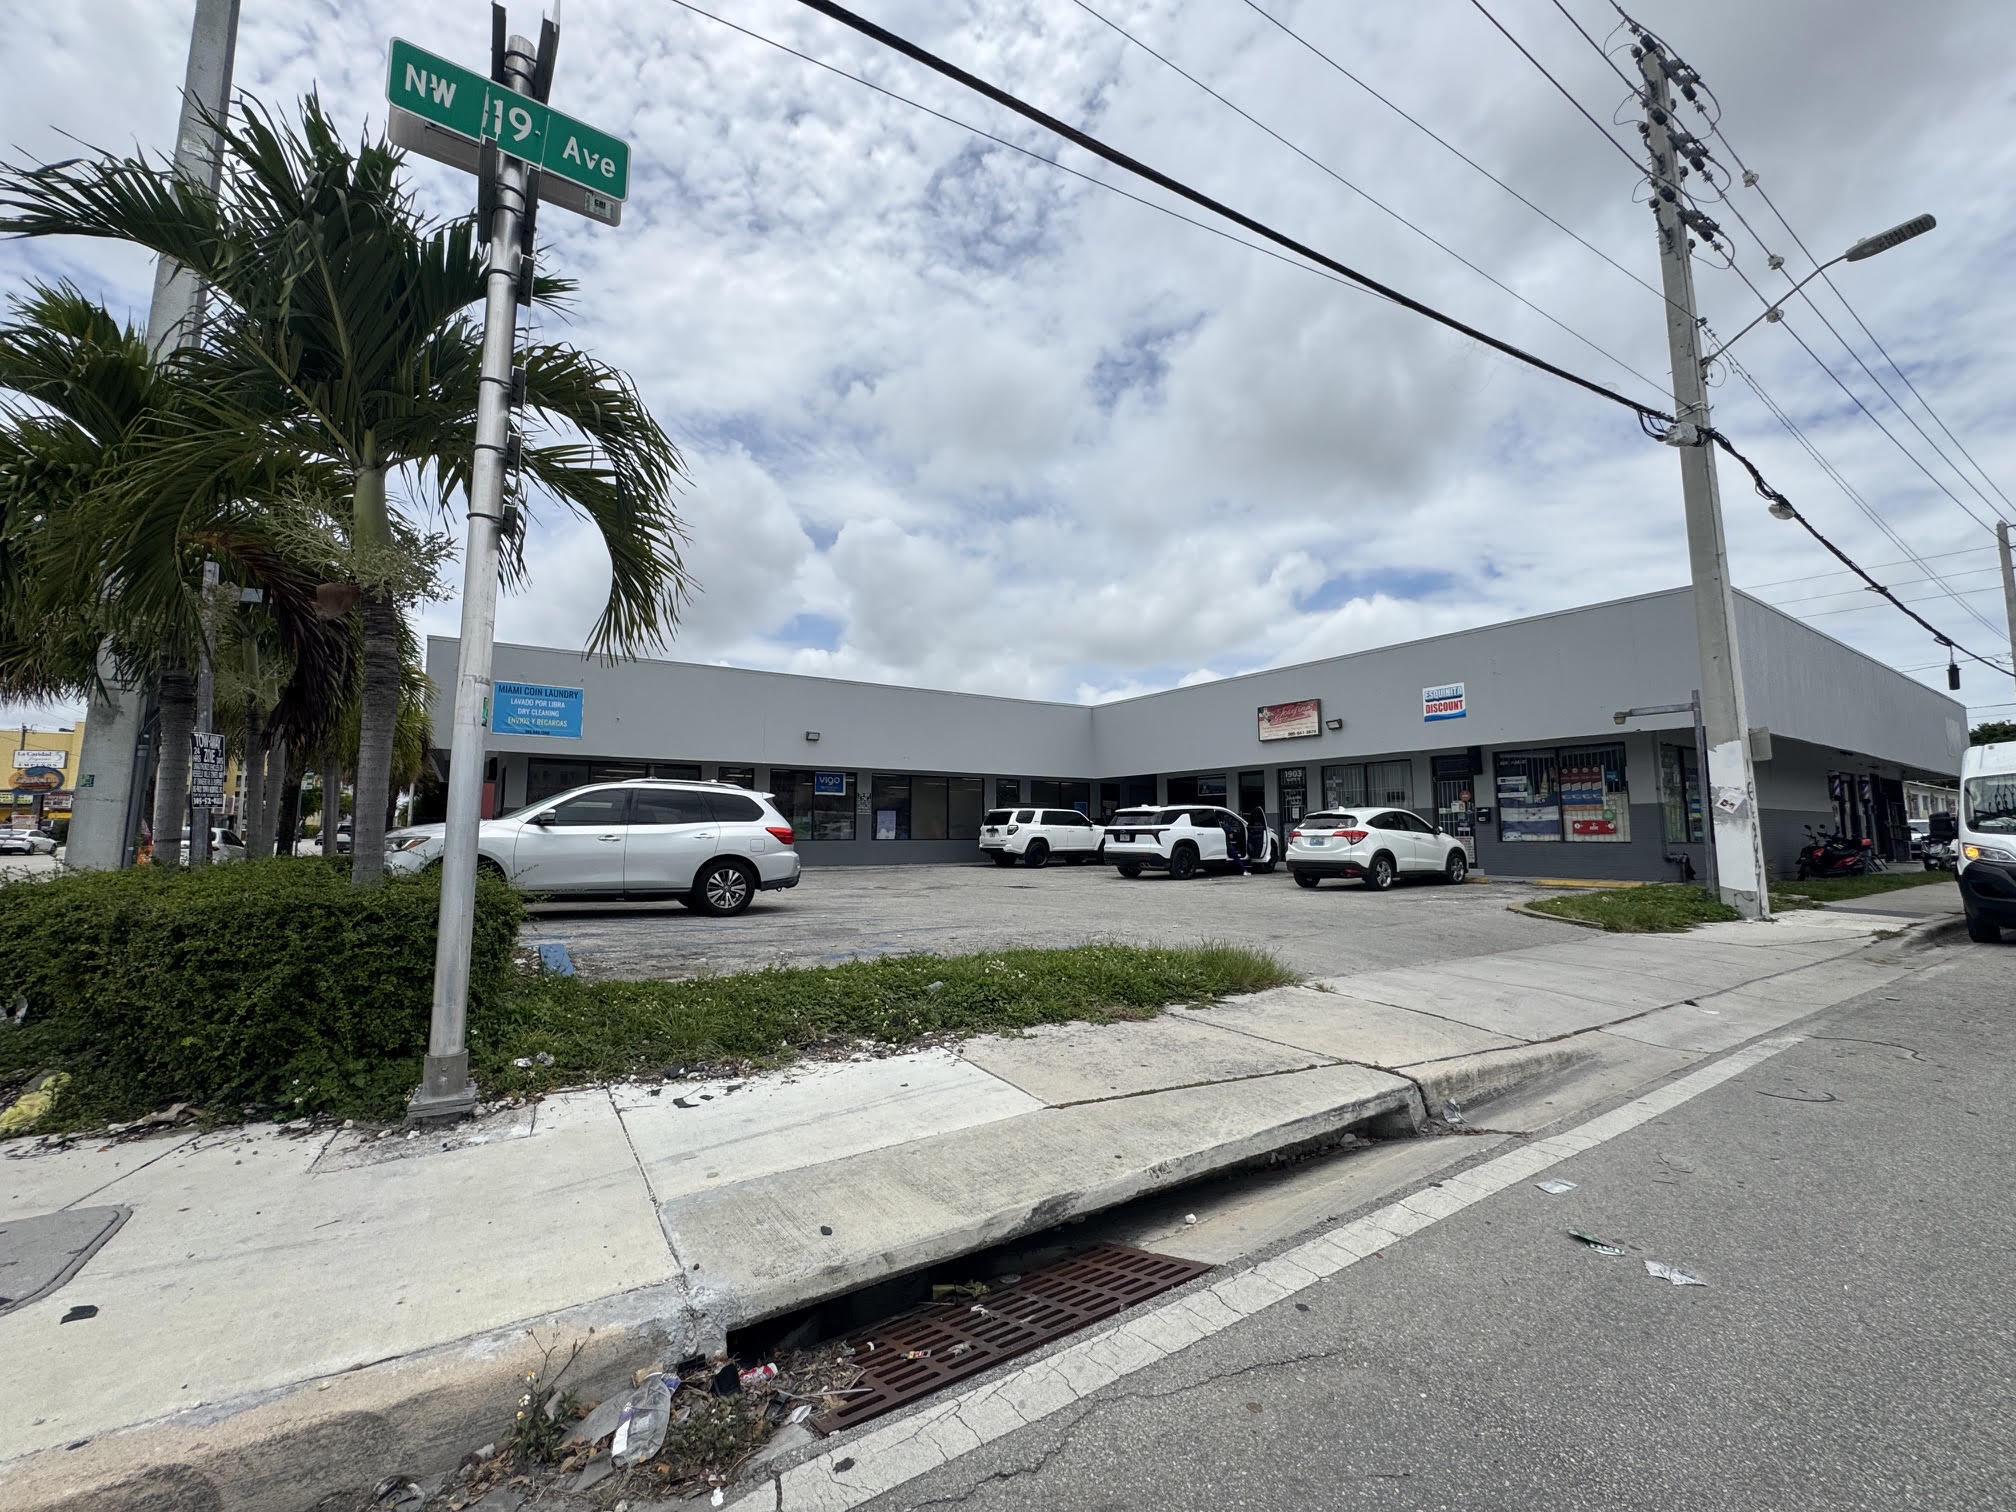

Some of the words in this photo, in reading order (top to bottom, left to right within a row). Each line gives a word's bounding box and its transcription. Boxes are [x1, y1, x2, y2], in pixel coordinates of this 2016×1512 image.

[405, 62, 457, 108] NW
[493, 98, 533, 142] 19
[562, 136, 616, 179] Ave
[498, 685, 522, 696] MIAMI
[524, 687, 543, 697] COIN
[545, 689, 579, 699] LAUNDRY
[511, 698, 533, 706] LAVADO
[548, 700, 566, 708] LIBRA
[1425, 700, 1464, 714] DISCOUNT
[531, 709, 560, 717] CLEANING
[537, 718, 568, 727] RECARGAS
[1284, 769, 1302, 778] 1903
